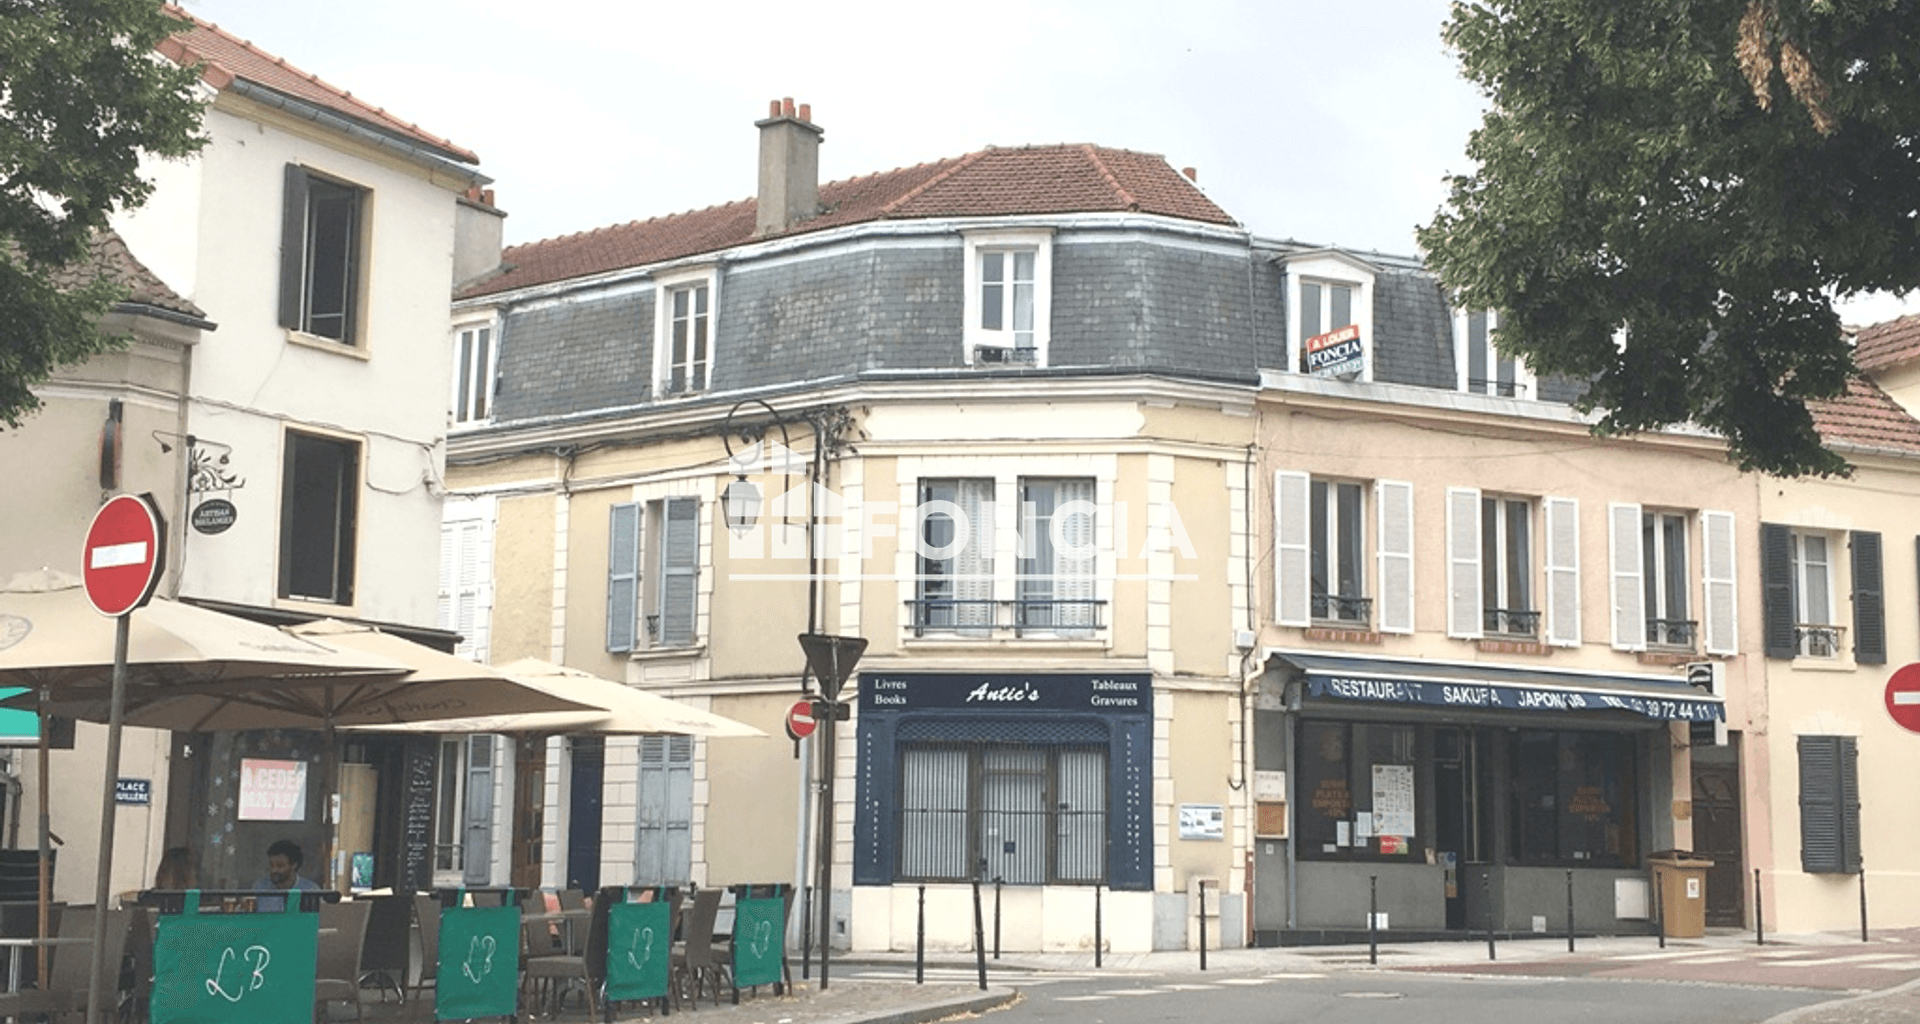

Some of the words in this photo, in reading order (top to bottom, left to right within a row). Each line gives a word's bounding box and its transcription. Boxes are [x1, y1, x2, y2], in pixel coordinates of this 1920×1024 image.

[1322, 328, 1355, 348] LOUER
[1310, 341, 1360, 366] FONCIA
[874, 678, 907, 690] Livres
[965, 681, 1040, 703] Antic's
[1091, 679, 1138, 691] Tableaux
[874, 693, 907, 705] Books
[1091, 694, 1138, 707] Gravures
[1442, 686, 1502, 706] SAKURA
[1647, 700, 1660, 717] 39
[1661, 701, 1676, 718] 72
[1678, 703, 1694, 719] 44
[116, 782, 146, 792] PLACE
[205, 944, 271, 1003] LB
